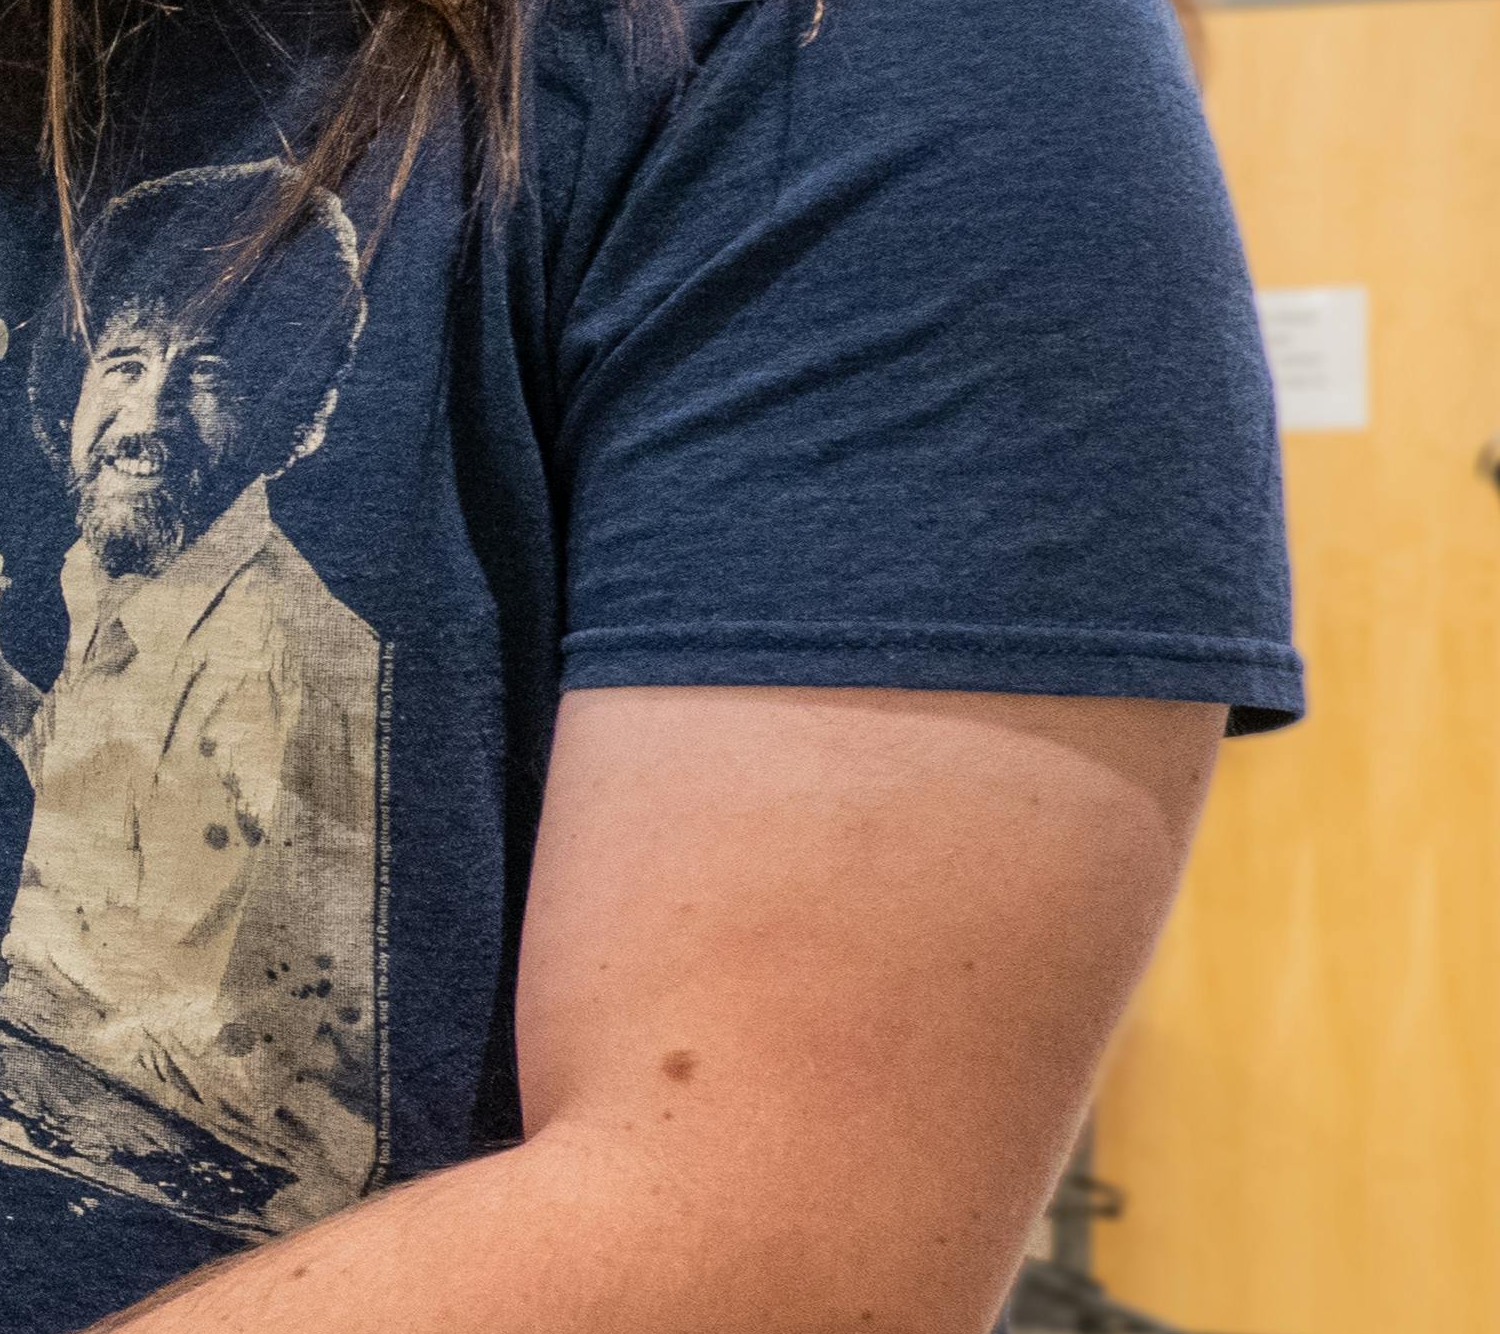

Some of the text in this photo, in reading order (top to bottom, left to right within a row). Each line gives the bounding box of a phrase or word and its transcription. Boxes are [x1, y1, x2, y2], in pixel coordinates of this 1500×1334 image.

[380, 736, 391, 803] trademarks
[379, 805, 392, 864] registered
[380, 865, 390, 885] are
[376, 886, 391, 933] Painting
[377, 935, 389, 948] of
[377, 952, 391, 973] Joy
[377, 975, 389, 998] The
[378, 1001, 389, 1024] and
[379, 1111, 390, 1140] Ross
[378, 1143, 391, 1164] Bob
